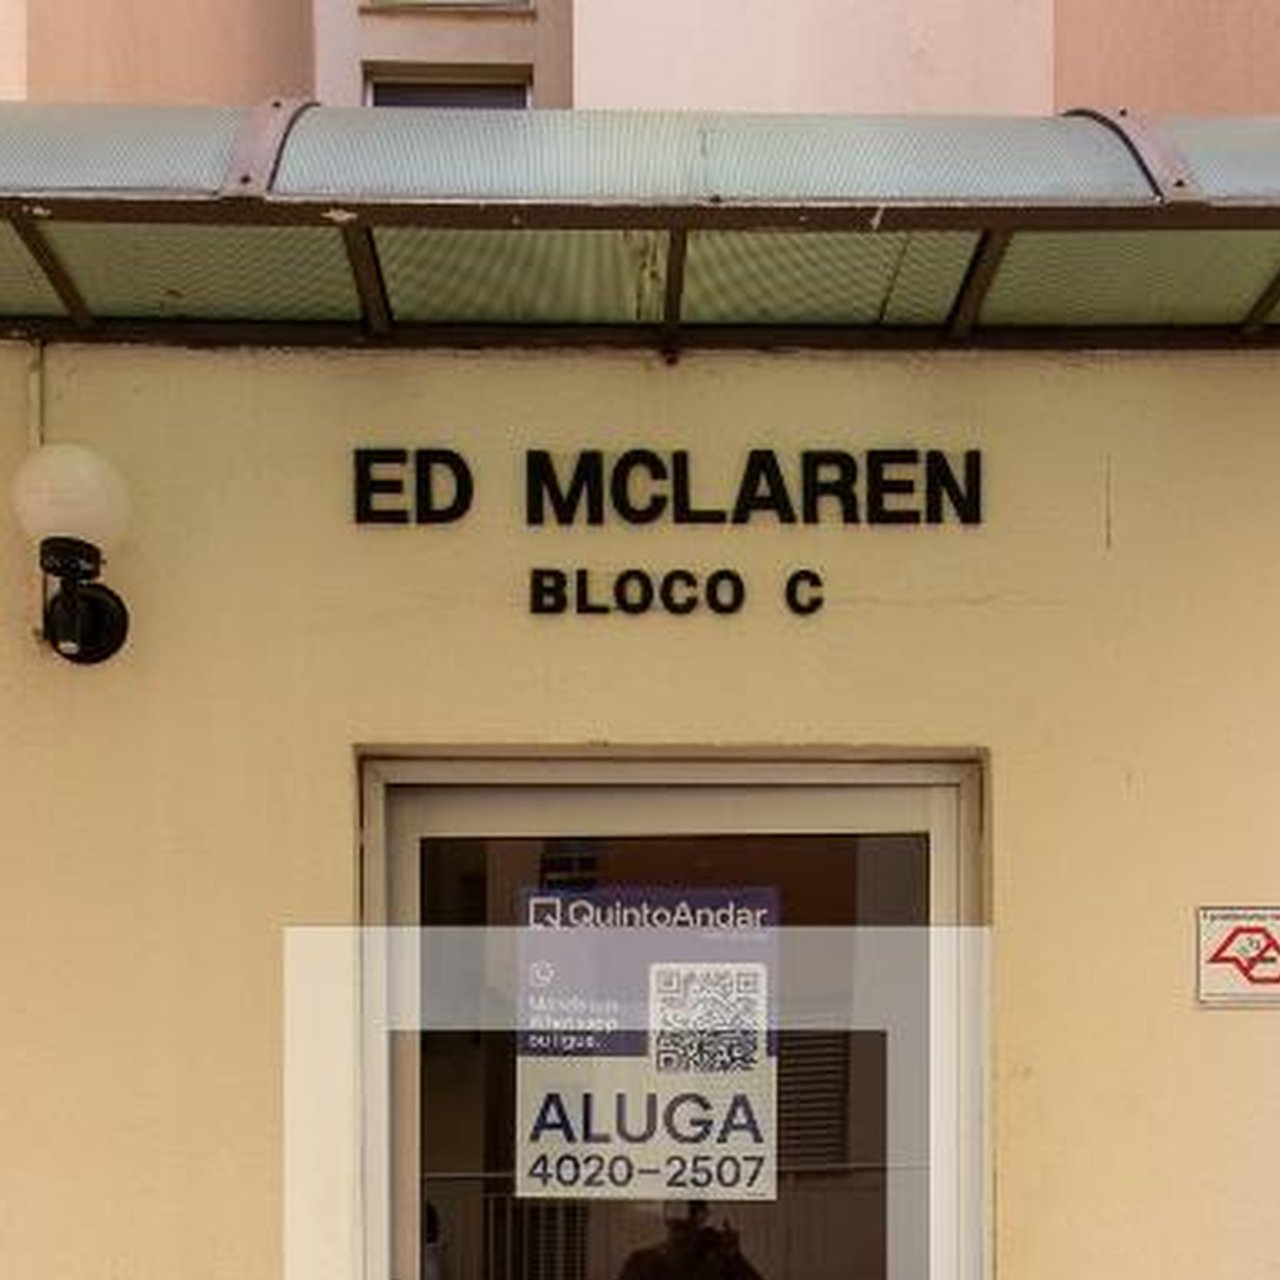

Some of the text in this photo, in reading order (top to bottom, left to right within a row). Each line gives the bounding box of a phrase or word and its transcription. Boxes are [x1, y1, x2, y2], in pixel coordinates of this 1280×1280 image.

[353, 448, 982, 525] ED MCLAREN
[530, 569, 824, 615] BLOCO C
[569, 900, 768, 927] QuintoAndar
[529, 1093, 764, 1143] ALUGA
[528, 1155, 765, 1188] 4020-2507
